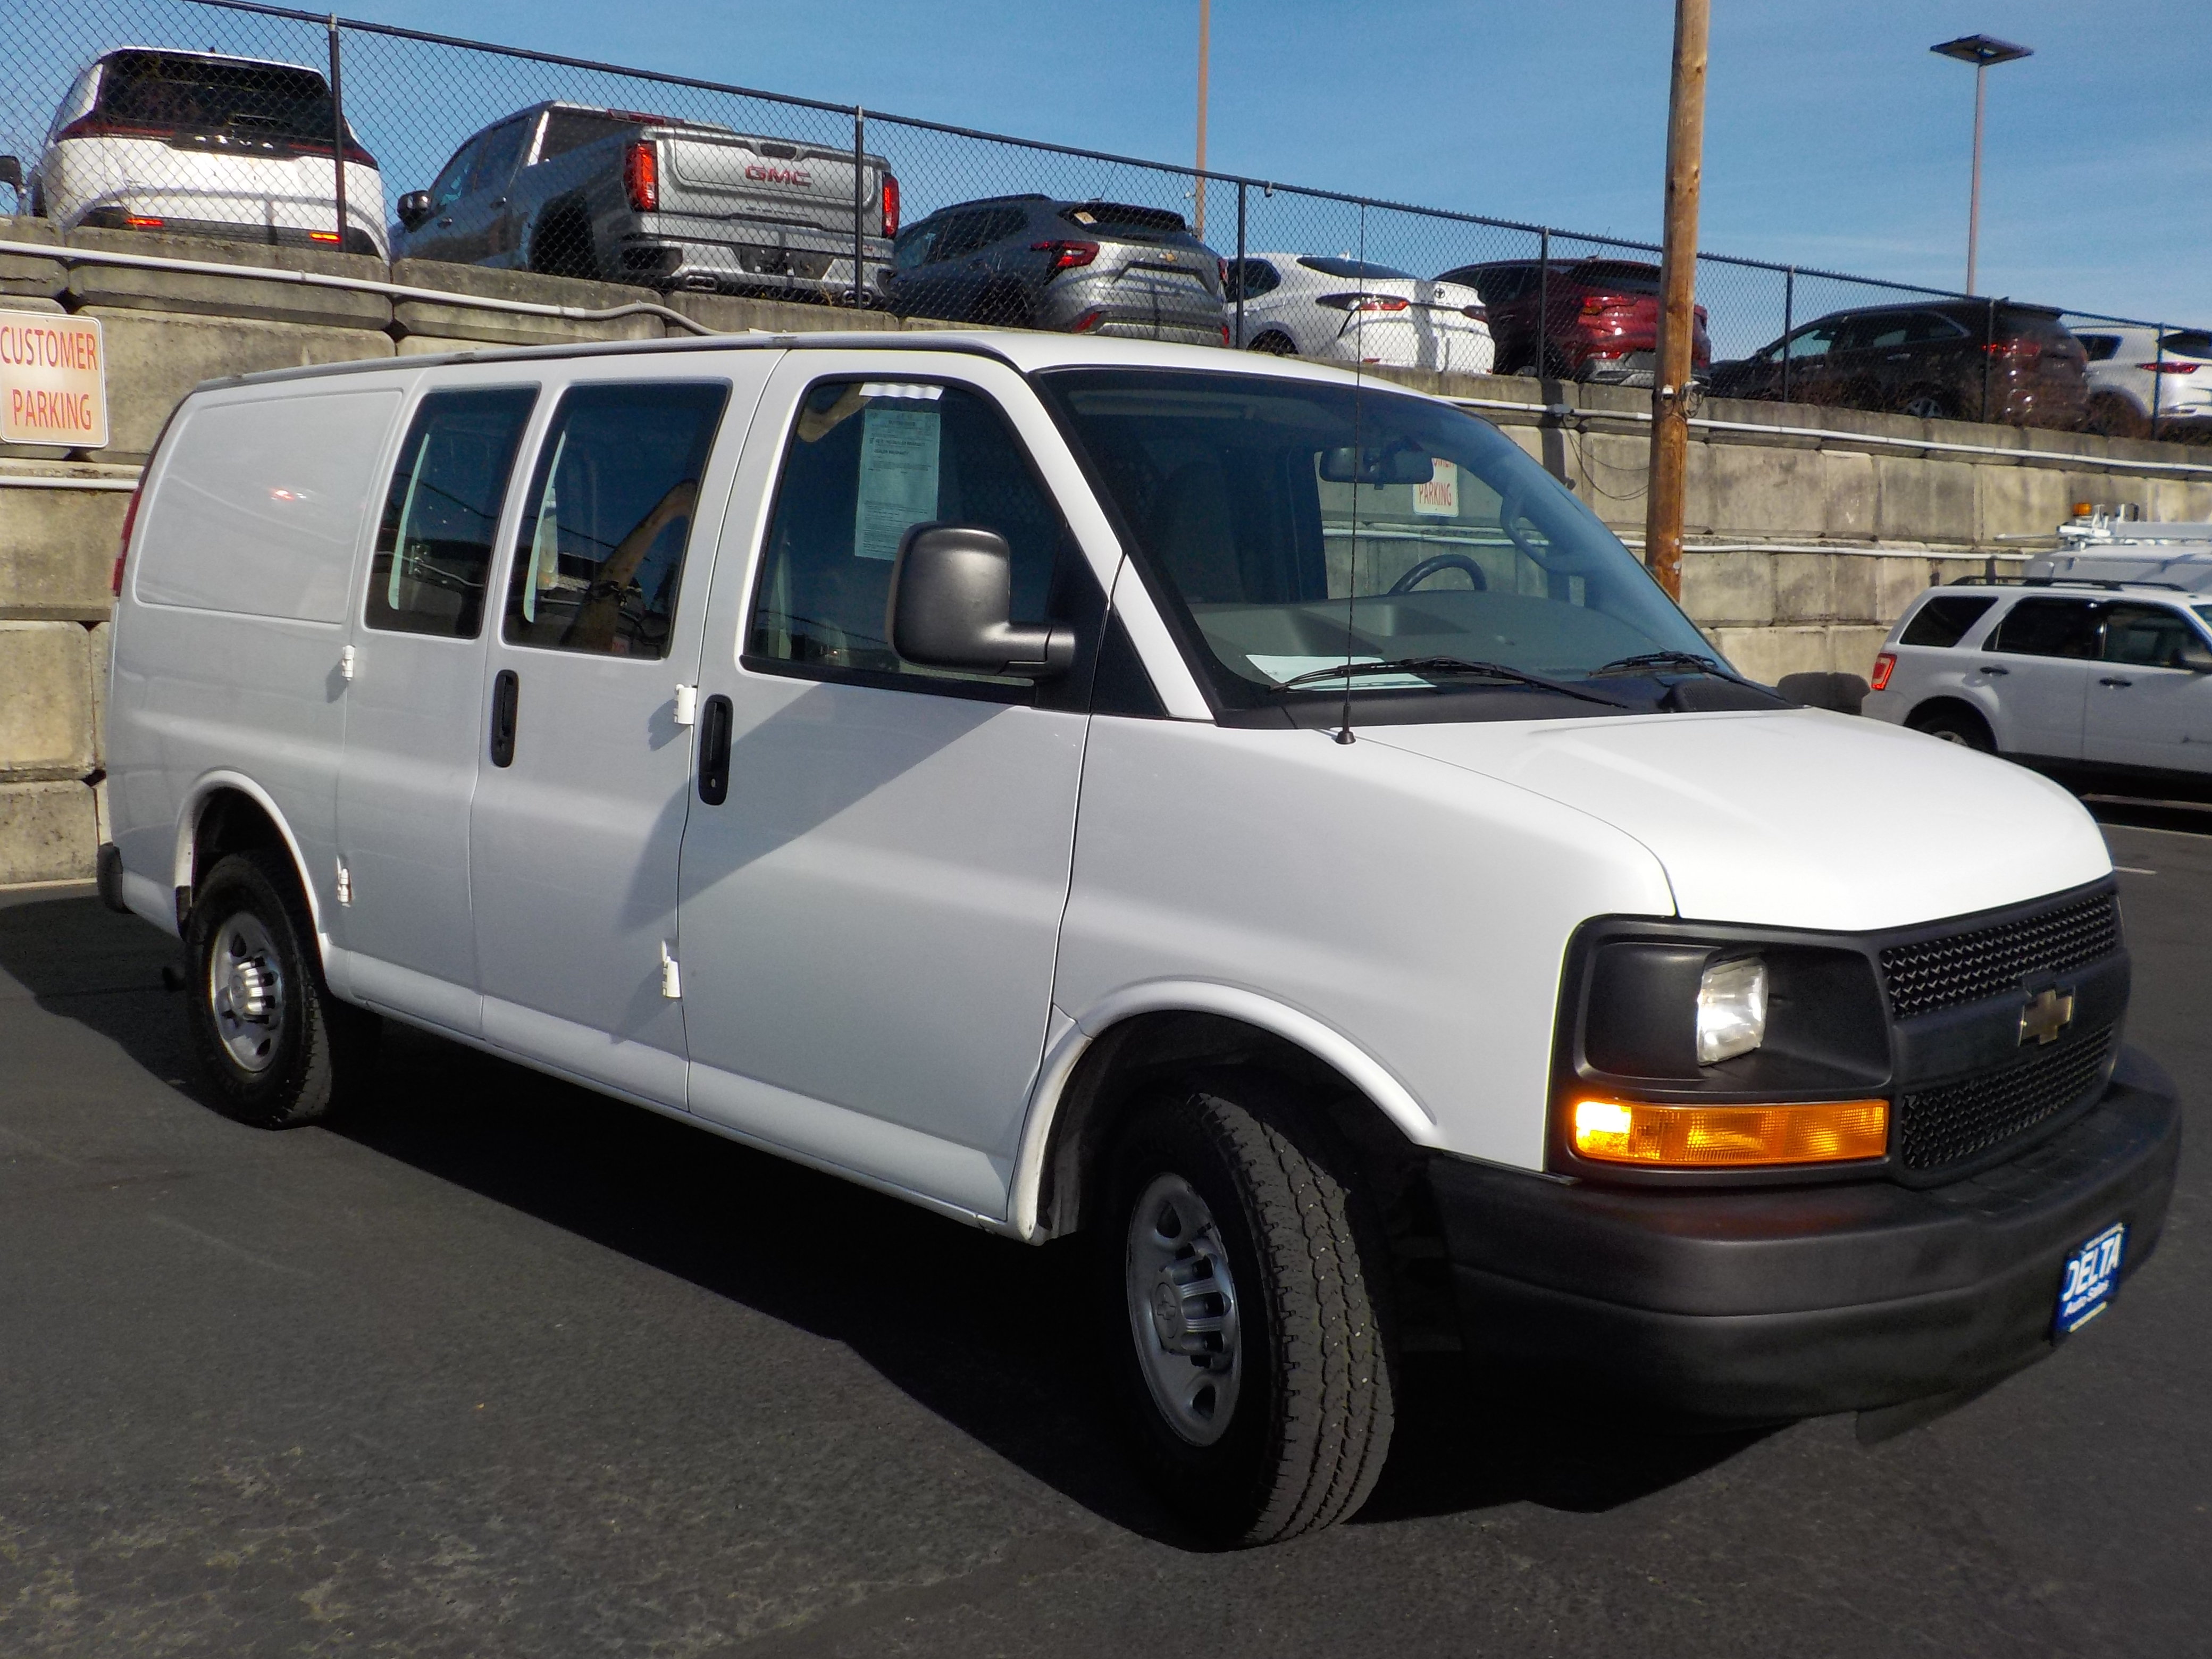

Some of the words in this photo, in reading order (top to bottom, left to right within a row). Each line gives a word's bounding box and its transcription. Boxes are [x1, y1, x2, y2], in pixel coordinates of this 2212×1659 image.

[745, 165, 812, 187] GMC
[1, 326, 97, 370] CUSTOMER
[12, 389, 91, 430] PARKING
[1419, 482, 1452, 506] PARKING
[2062, 1233, 2122, 1302] DELTA
